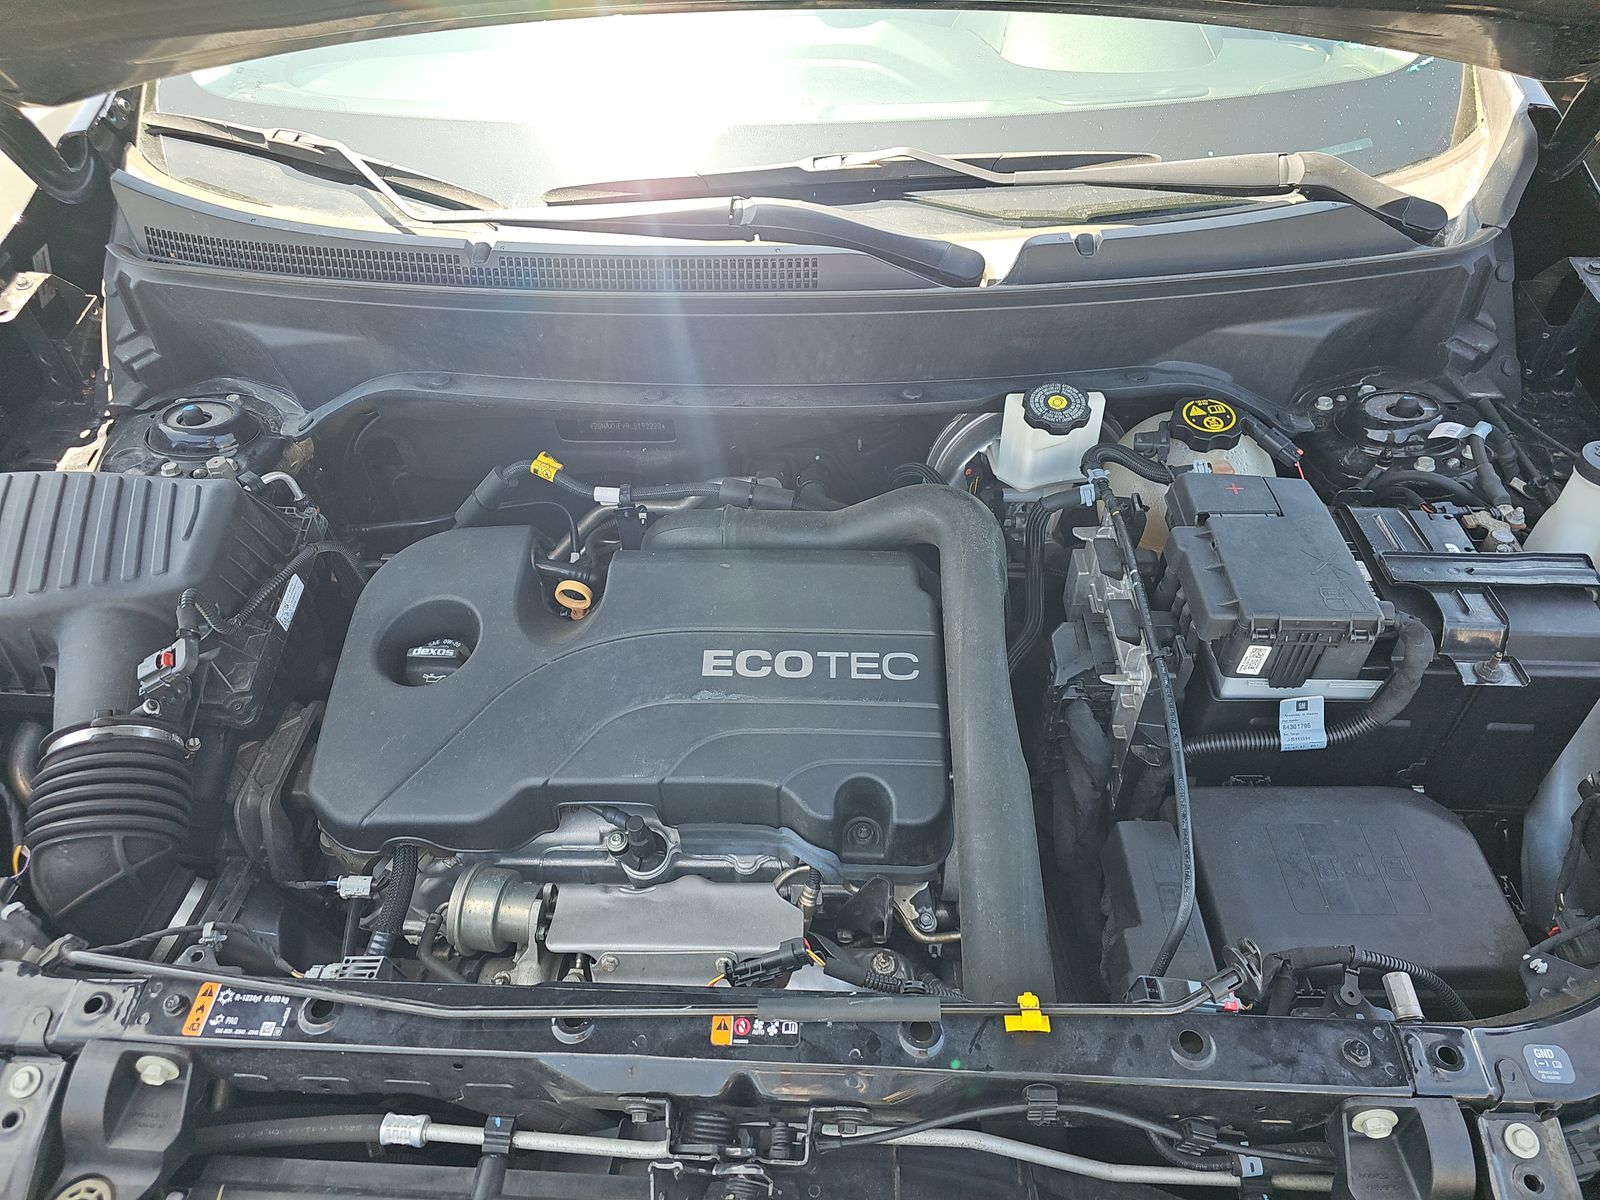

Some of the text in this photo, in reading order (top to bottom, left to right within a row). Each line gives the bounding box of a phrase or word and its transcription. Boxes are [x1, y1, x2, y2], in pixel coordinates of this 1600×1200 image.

[412, 646, 454, 656] dexos
[701, 649, 920, 681] ECOTEC
[234, 993, 262, 1003] R-1234yf
[281, 995, 290, 1005] kg
[1533, 1048, 1554, 1059] GND
